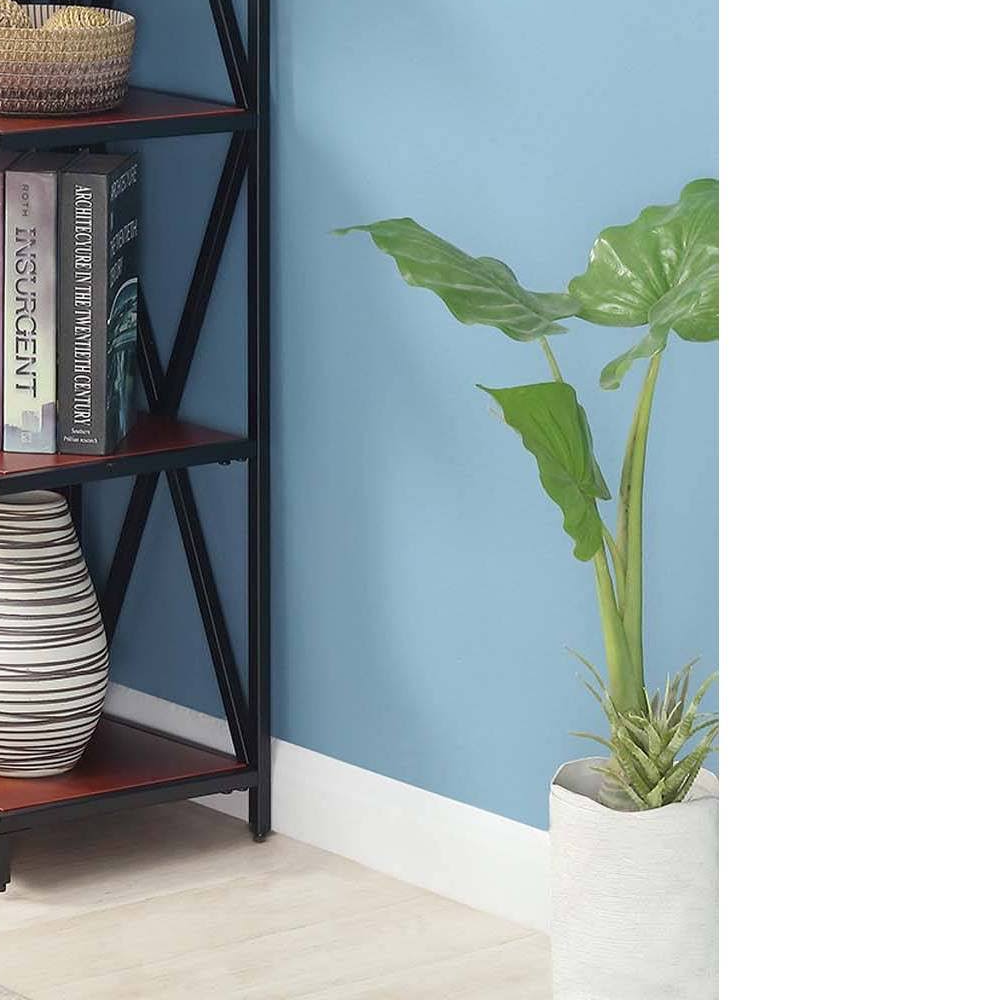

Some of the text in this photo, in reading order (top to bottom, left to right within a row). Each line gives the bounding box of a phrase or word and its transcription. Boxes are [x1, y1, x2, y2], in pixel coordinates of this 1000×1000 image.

[21, 183, 30, 217] ROTH
[74, 271, 91, 284] IN
[74, 285, 91, 307] THE
[15, 227, 37, 399] INSURGENT
[74, 309, 91, 373] TWENTIETH
[73, 374, 91, 426] CENTURY
